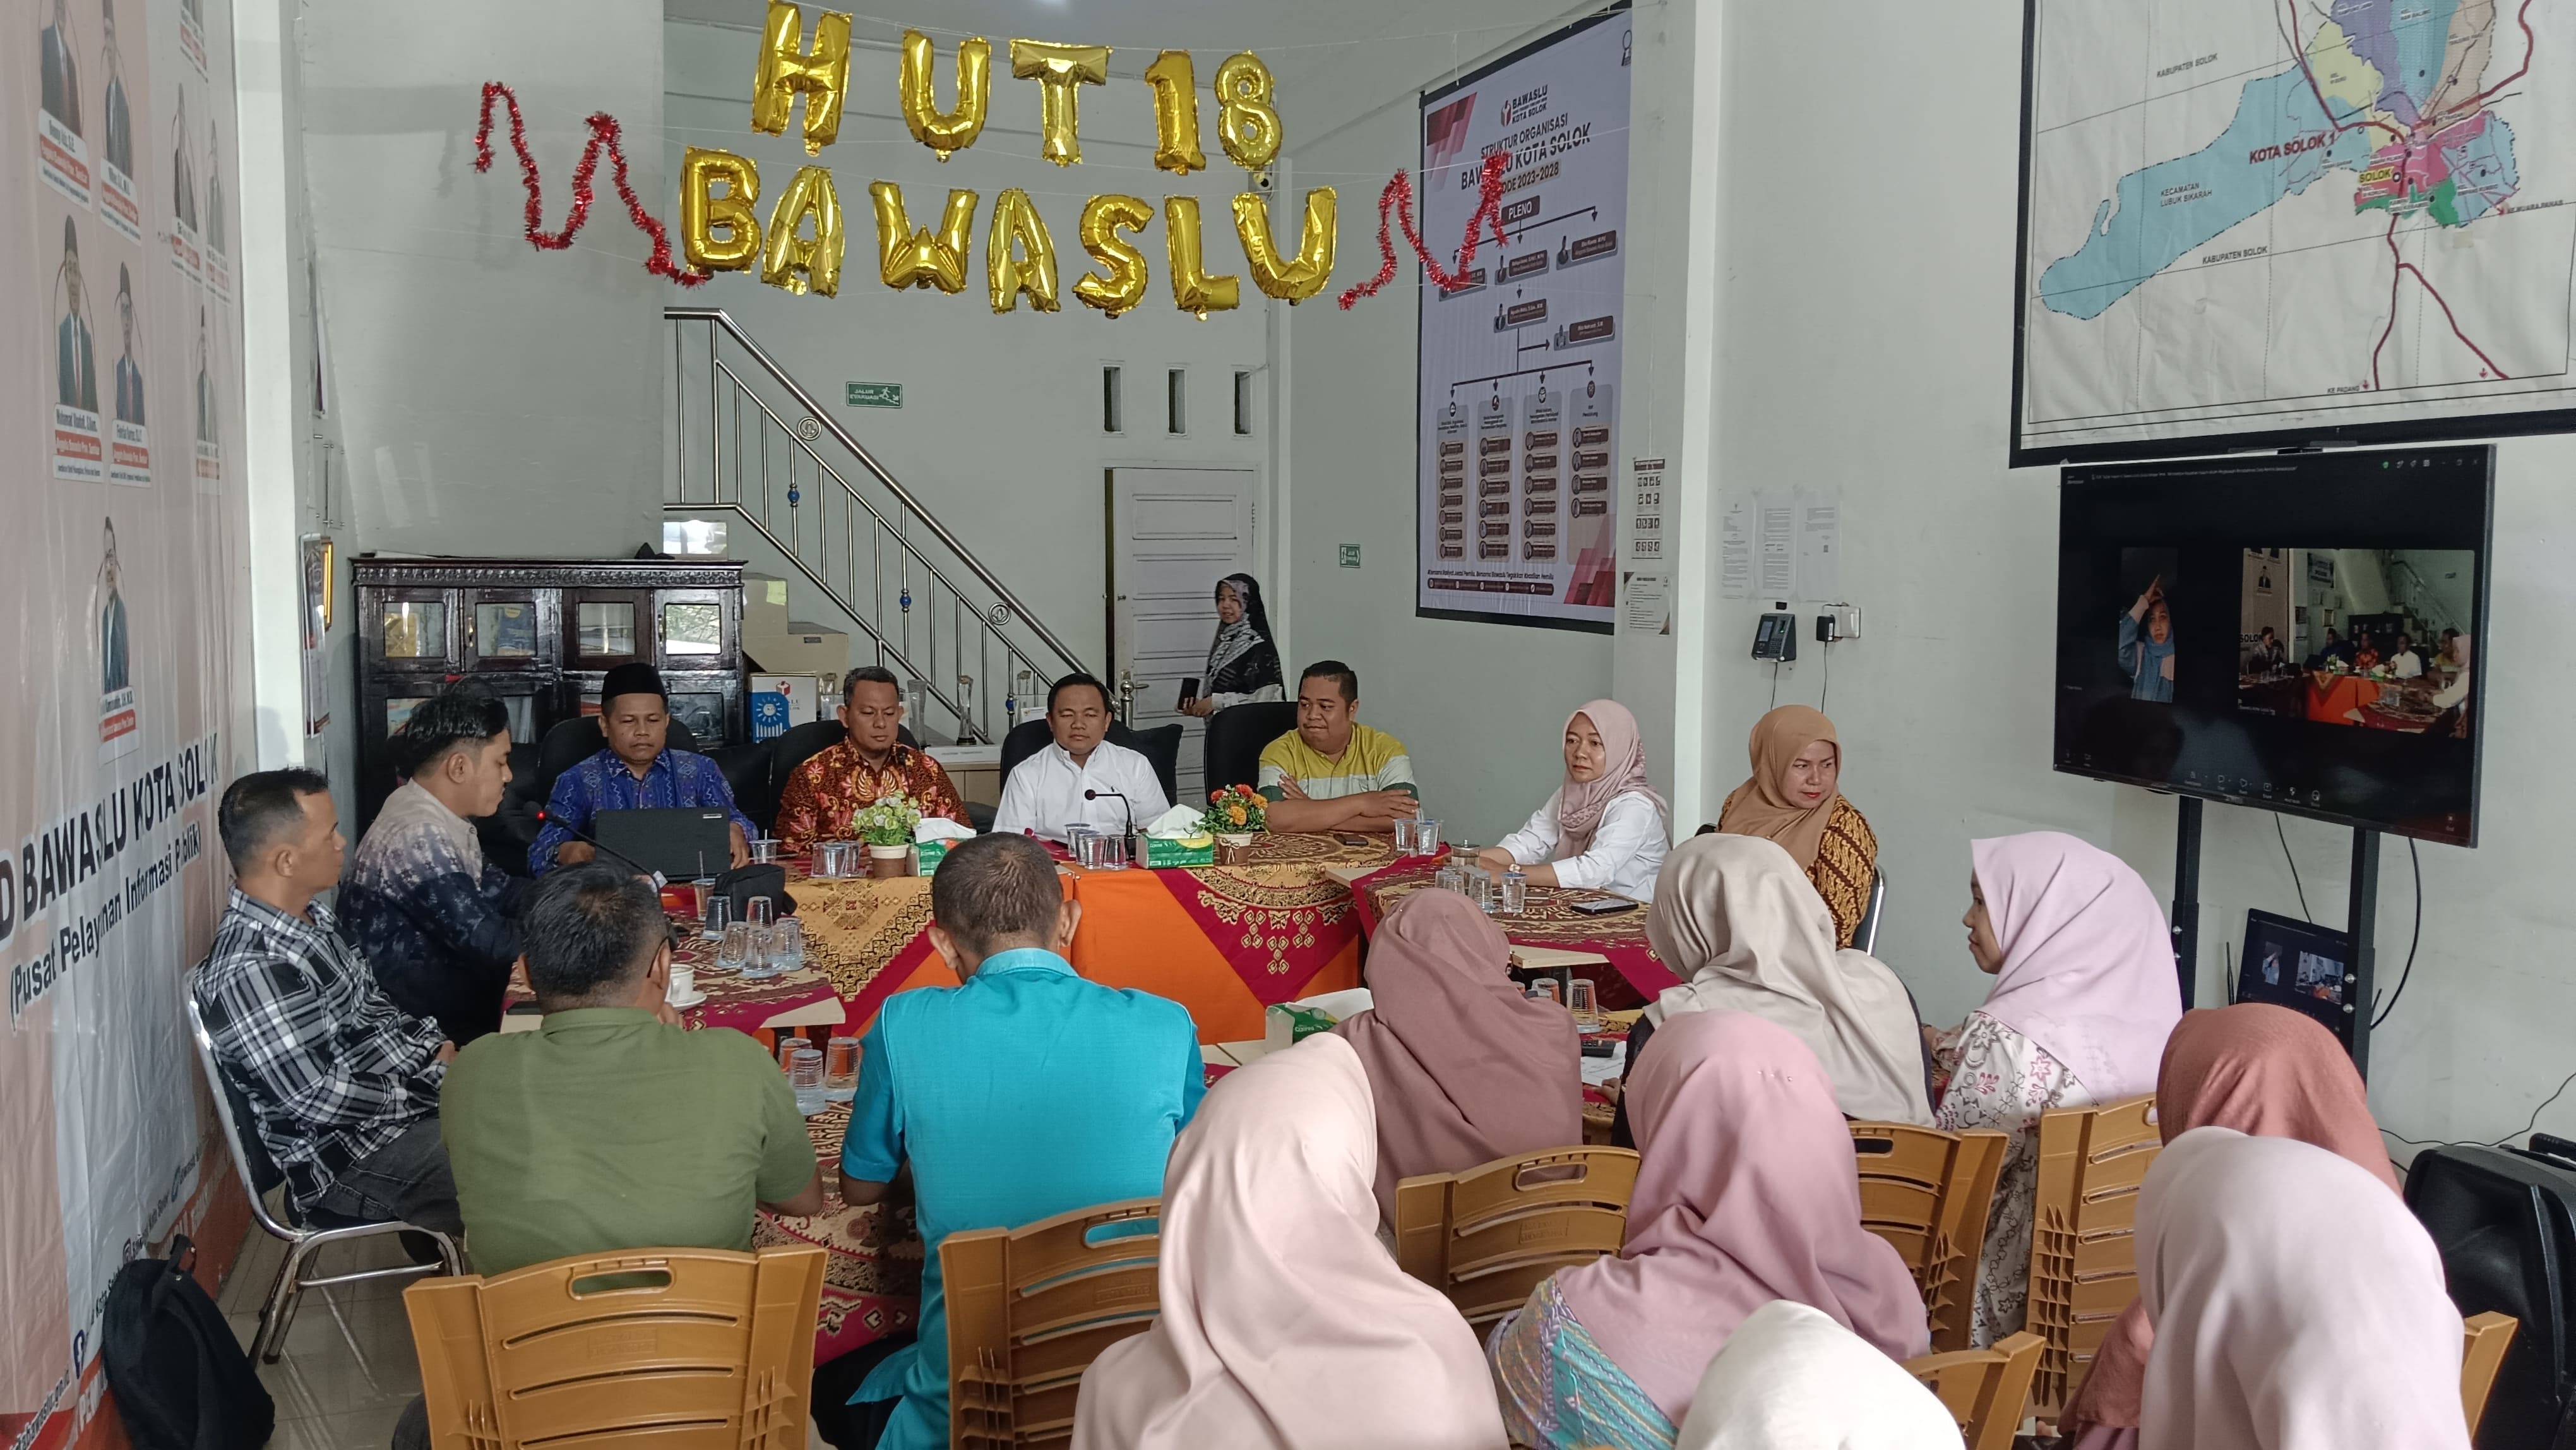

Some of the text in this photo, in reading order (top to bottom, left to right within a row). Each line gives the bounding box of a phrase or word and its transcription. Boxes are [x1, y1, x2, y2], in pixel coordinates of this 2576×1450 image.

[2195, 53, 2217, 66] SOLOK
[751, 0, 1283, 176] HUT 18
[1513, 85, 1547, 110] BAWASLU
[1512, 112, 1527, 124] KOTA
[1528, 102, 1547, 118] SOLOK
[1481, 112, 1568, 159] STRUKTUR ORGANISASI
[1515, 140, 1547, 170] KOTA
[1550, 122, 1590, 156] SOLOK
[2250, 145, 2281, 164] KOTA
[2284, 133, 2326, 156] SOLOK
[1518, 161, 1559, 189] 2023-2028
[2359, 168, 2391, 183] SOLOK
[2161, 183, 2199, 196] KECAMATAN
[2161, 189, 2212, 207] LUBUK SIKARAH
[1508, 201, 1532, 220] PLENO
[679, 144, 1338, 320] BAWASLU
[2202, 246, 2267, 265] KABUPATEN SOLOK
[23, 787, 126, 923] BAWASLU
[133, 762, 176, 841] KOTA
[10, 947, 57, 1031] (Pusat
[126, 843, 172, 915] Informasi
[176, 820, 201, 873] Pblik)
